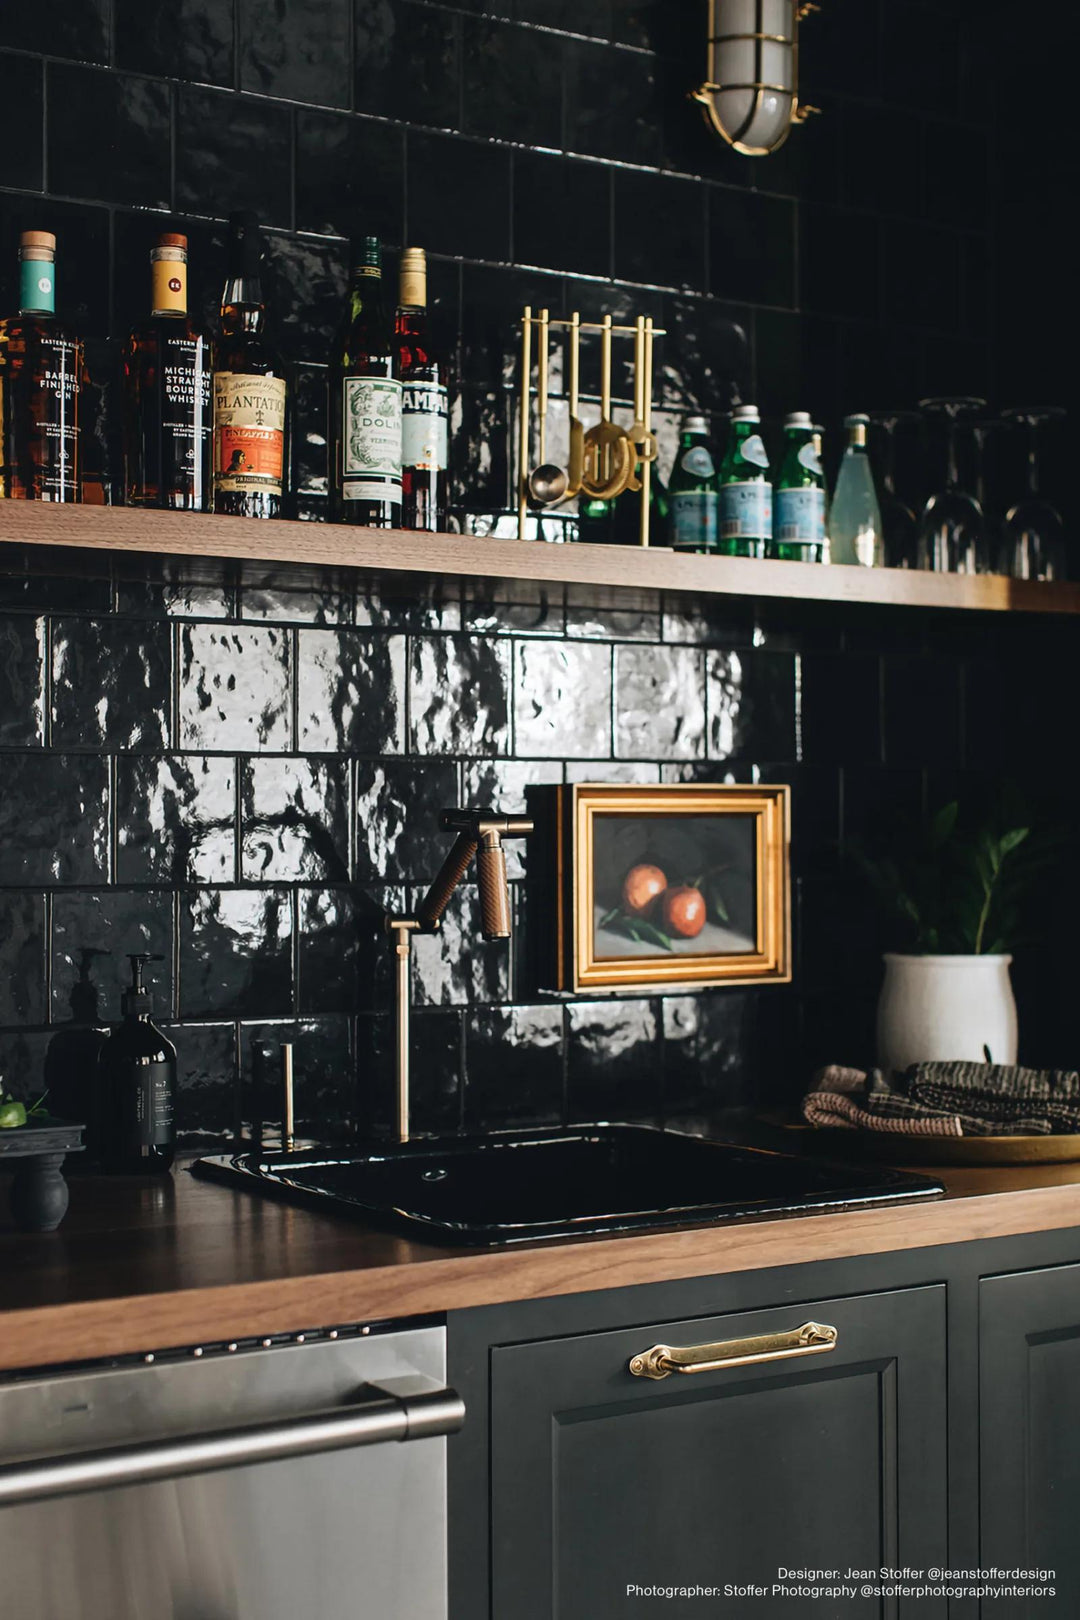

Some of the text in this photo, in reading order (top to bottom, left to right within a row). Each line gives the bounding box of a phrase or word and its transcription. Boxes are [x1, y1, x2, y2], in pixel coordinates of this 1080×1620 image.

[168, 339, 195, 347] EASTERN
[45, 370, 78, 384] BARREL
[164, 366, 211, 380] MICHIAN
[166, 375, 210, 389] STRAIHT
[55, 390, 71, 400] GN
[166, 385, 210, 398] BOURON
[168, 394, 209, 407] WHISEY
